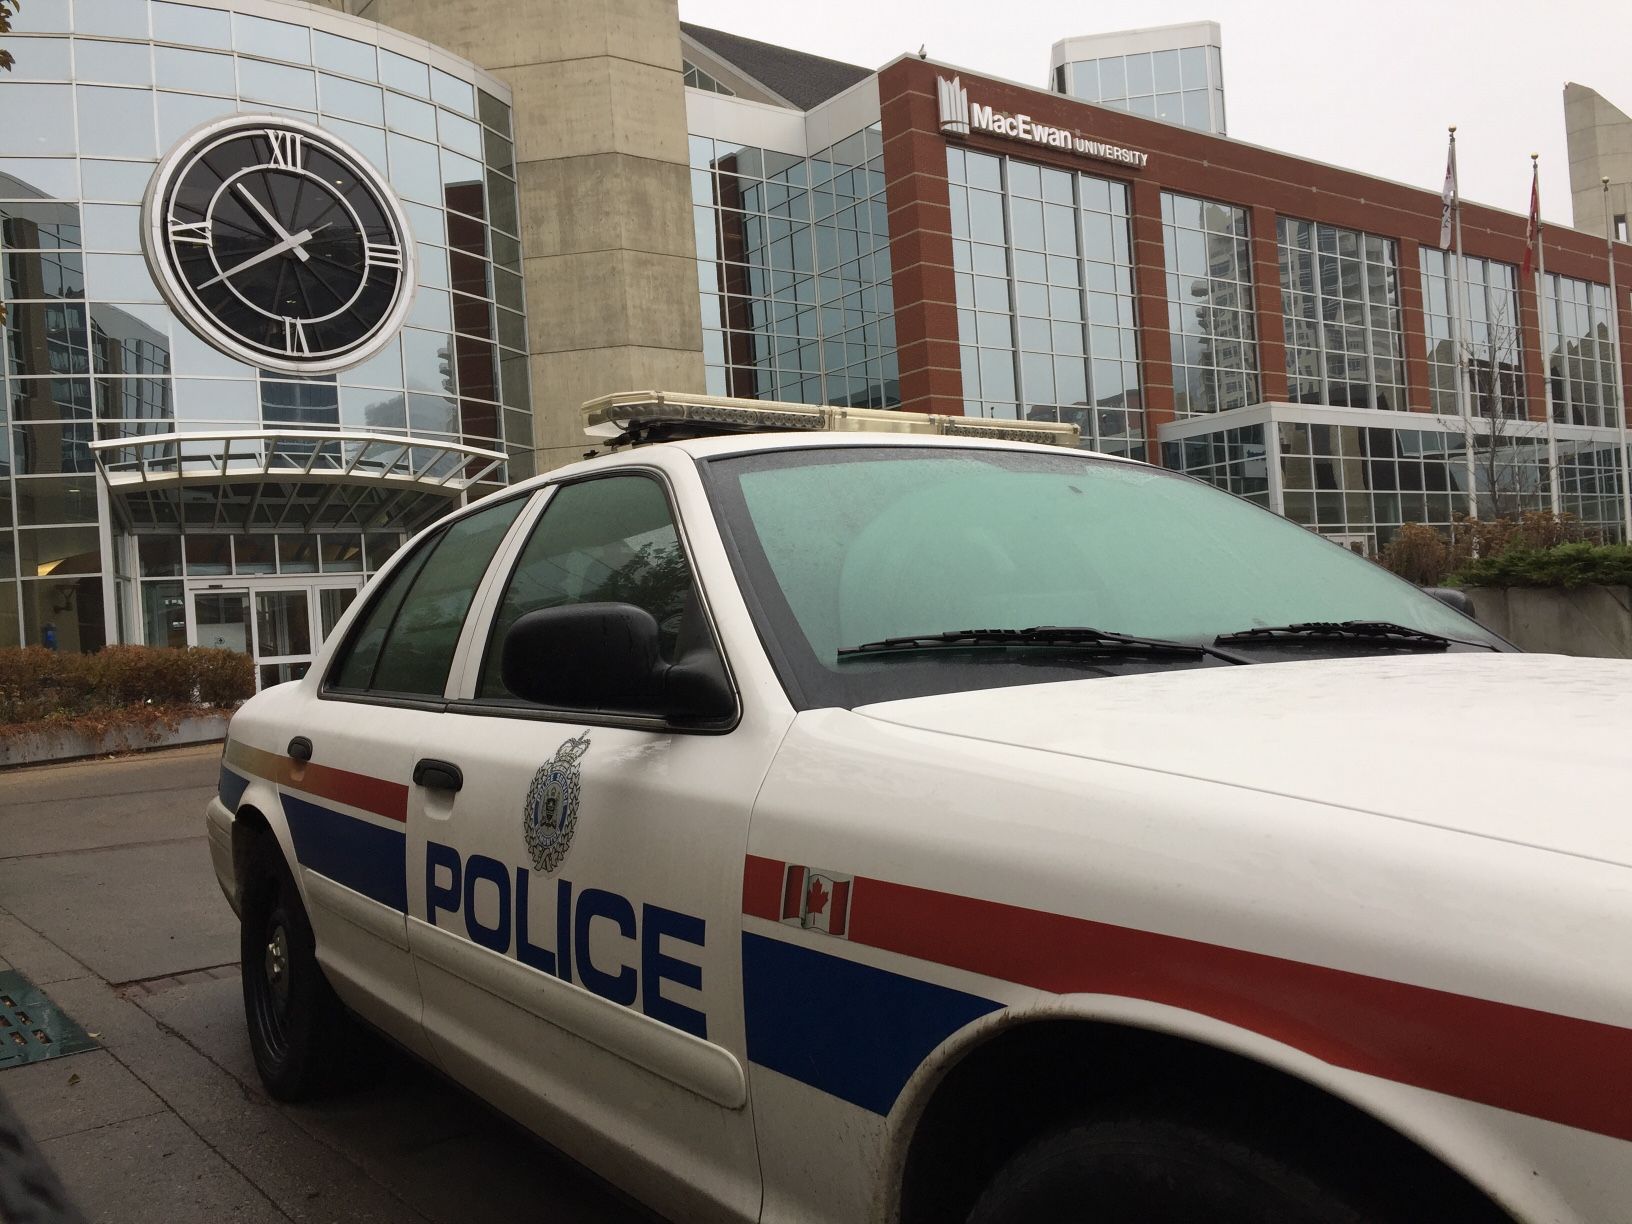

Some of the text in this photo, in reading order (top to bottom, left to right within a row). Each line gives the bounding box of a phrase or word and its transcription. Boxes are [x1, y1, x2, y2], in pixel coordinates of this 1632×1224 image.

[263, 129, 304, 174] XII
[971, 102, 1148, 167] MacEwan UNIVERSITY
[365, 242, 403, 271] III
[426, 840, 708, 1041] POLICE
